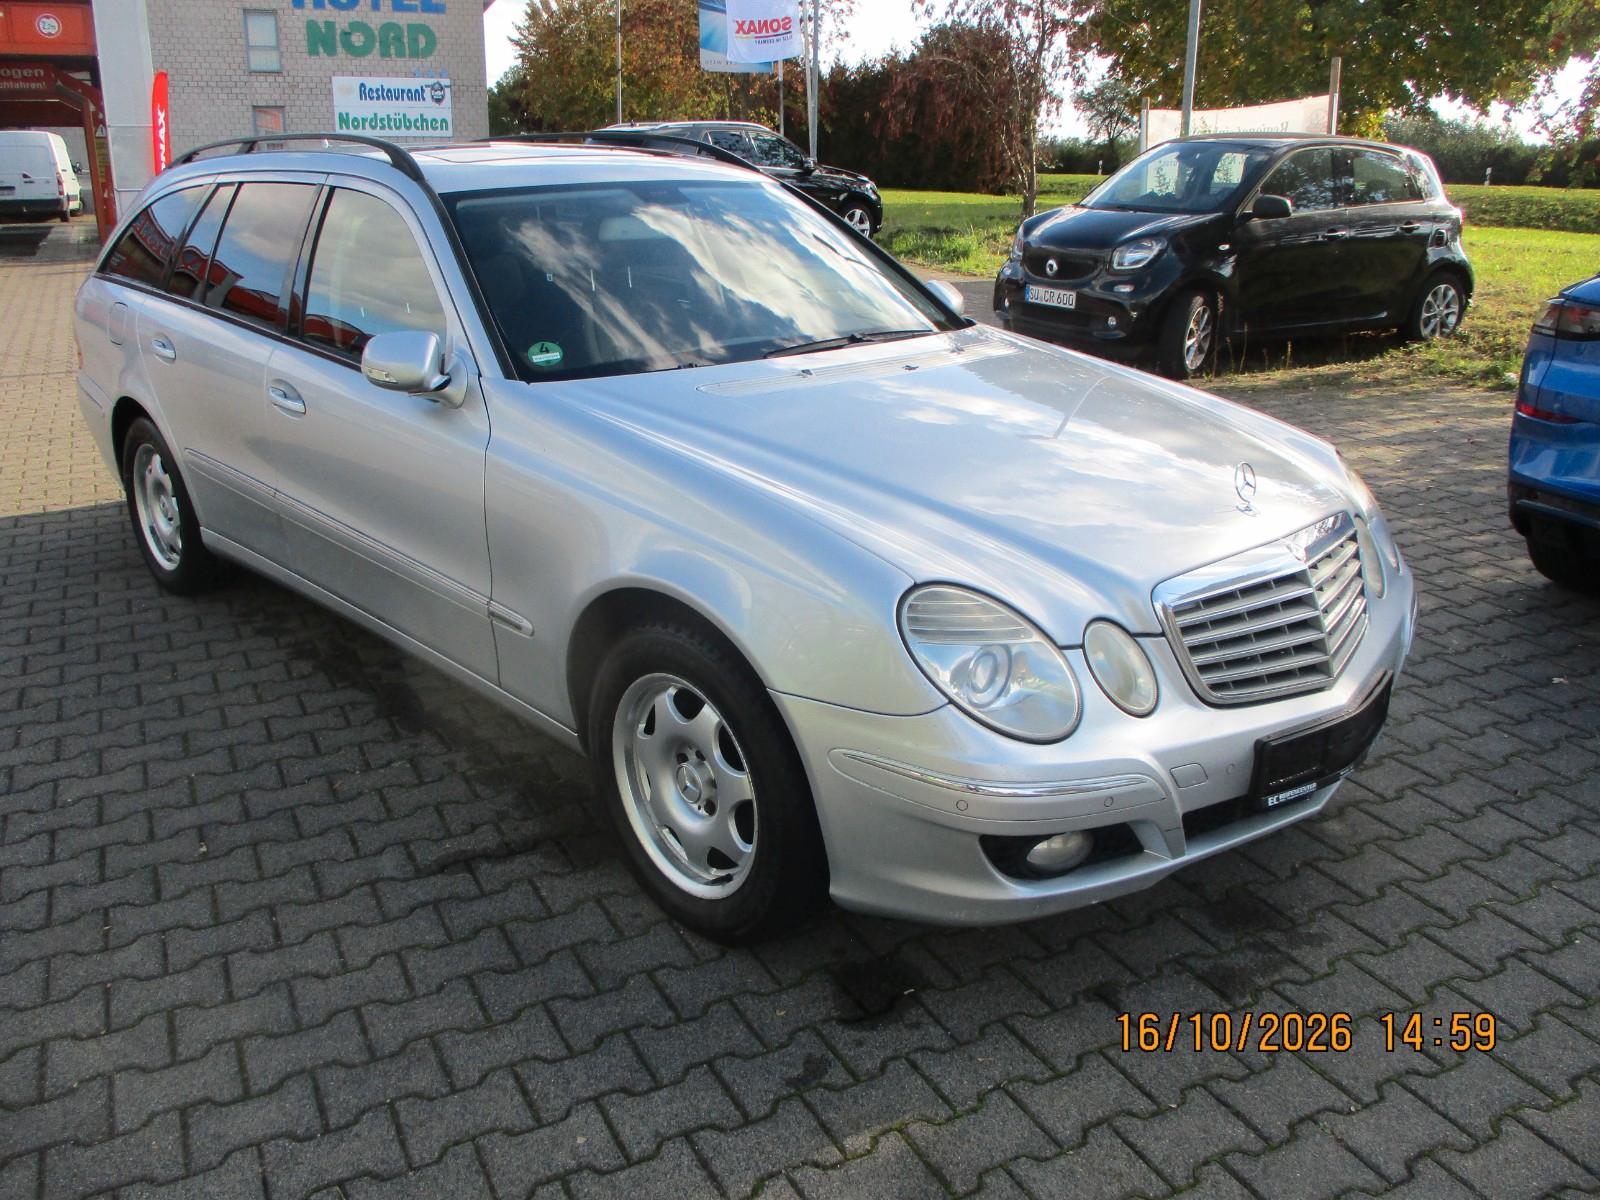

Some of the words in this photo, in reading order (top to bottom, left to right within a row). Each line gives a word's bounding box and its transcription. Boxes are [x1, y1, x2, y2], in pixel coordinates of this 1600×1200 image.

[306, 19, 436, 58] NORD
[359, 82, 426, 102] Restaurant
[338, 111, 449, 131] Nordstübchen
[1044, 289, 1055, 303] CR
[1056, 292, 1074, 306] 600
[540, 343, 550, 353] 4
